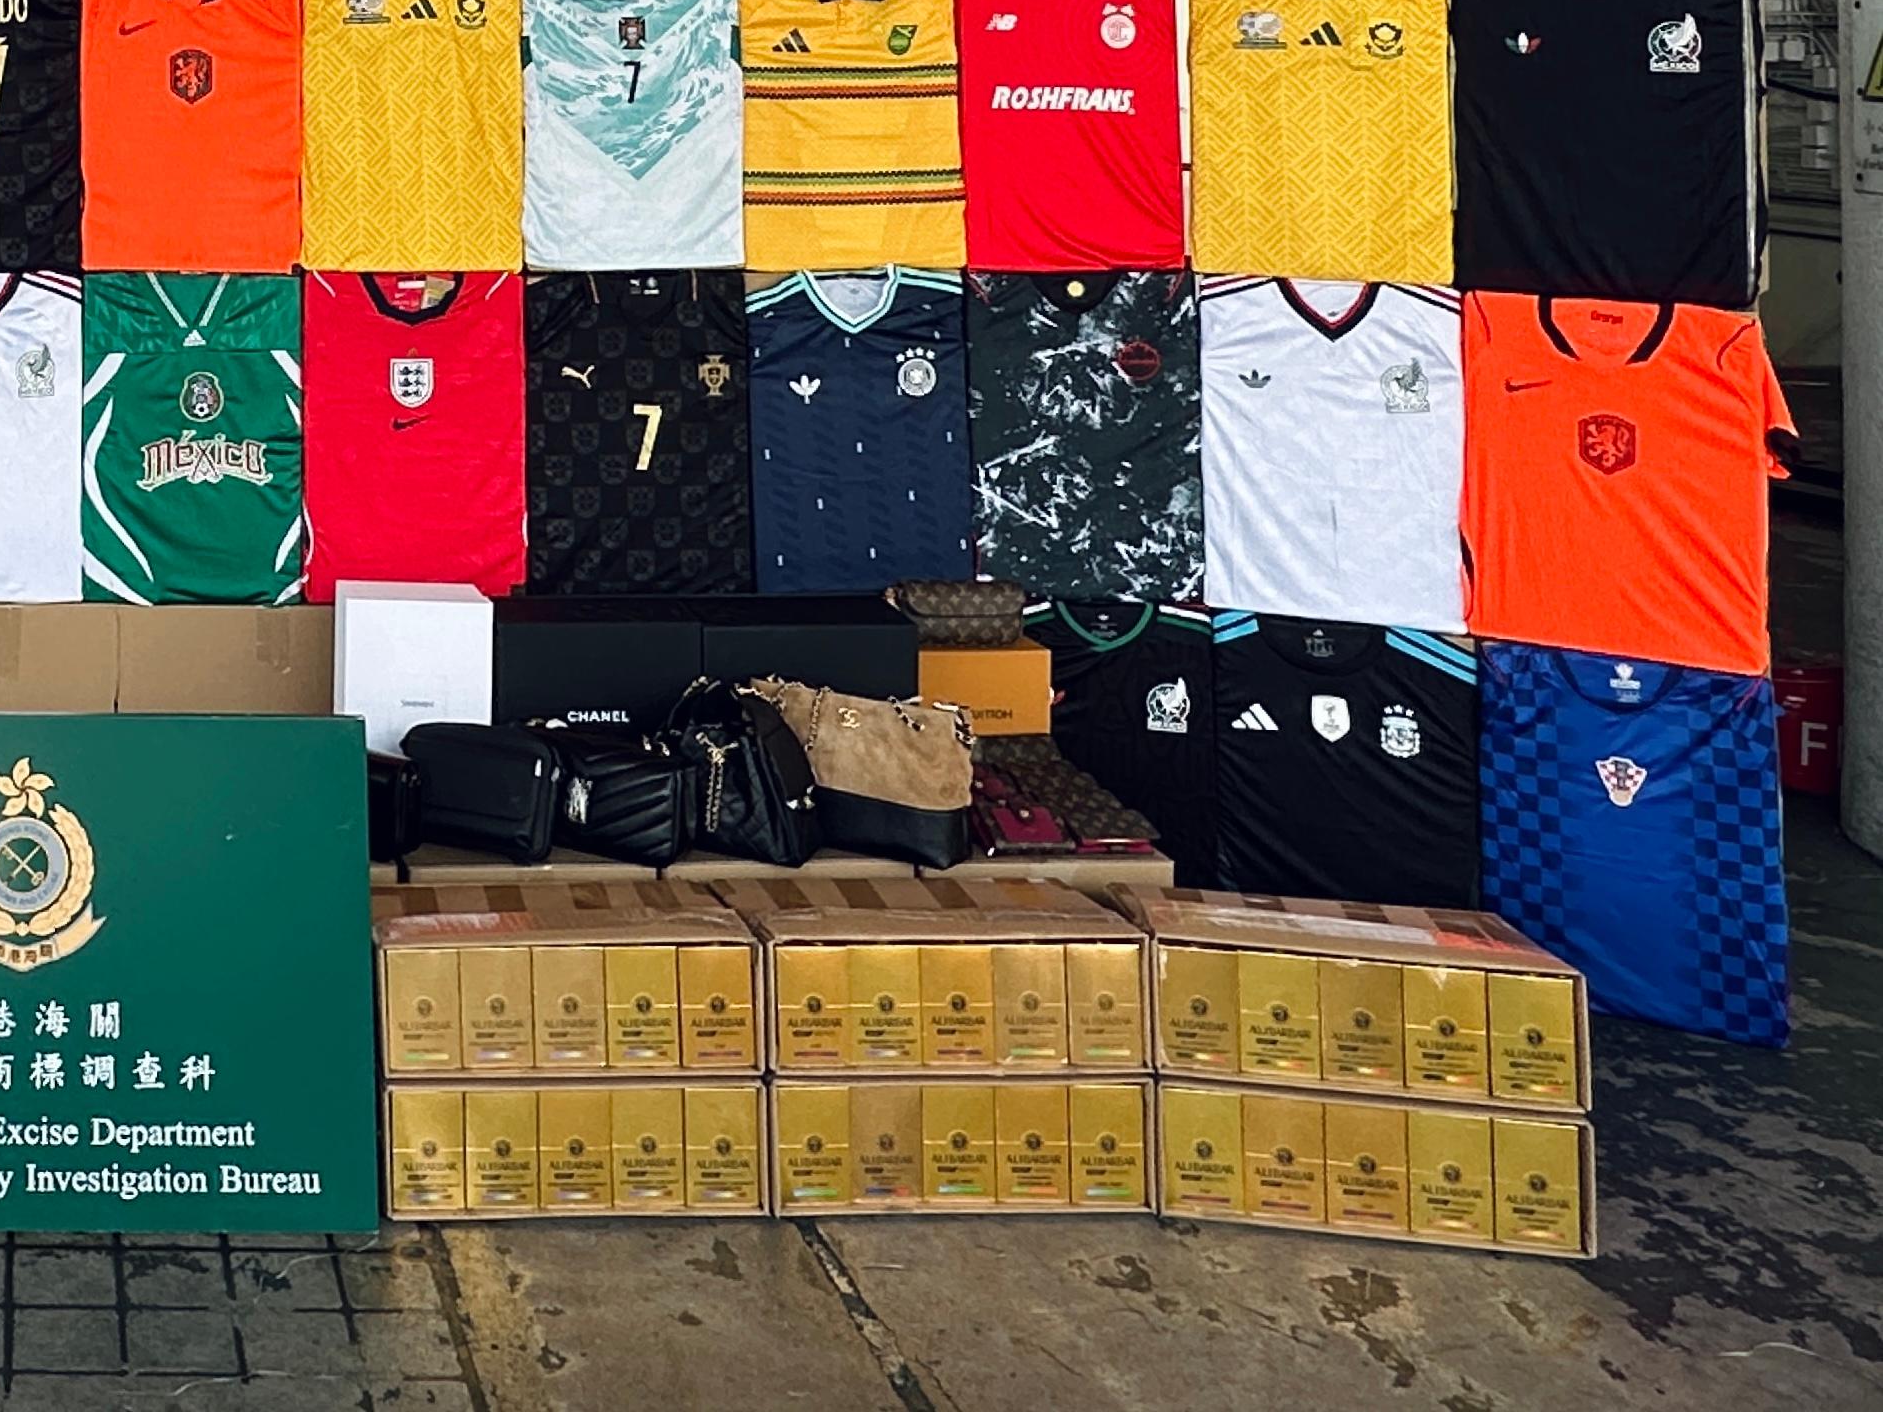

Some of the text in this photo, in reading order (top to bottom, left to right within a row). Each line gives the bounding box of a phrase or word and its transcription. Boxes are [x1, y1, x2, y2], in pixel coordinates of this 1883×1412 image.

[623, 61, 642, 104] 7
[633, 403, 663, 471] 7
[567, 710, 630, 723] CHANEL
[90, 1117, 256, 1154] Department
[25, 1163, 209, 1201] Investigation
[219, 1164, 323, 1195] Bureau
